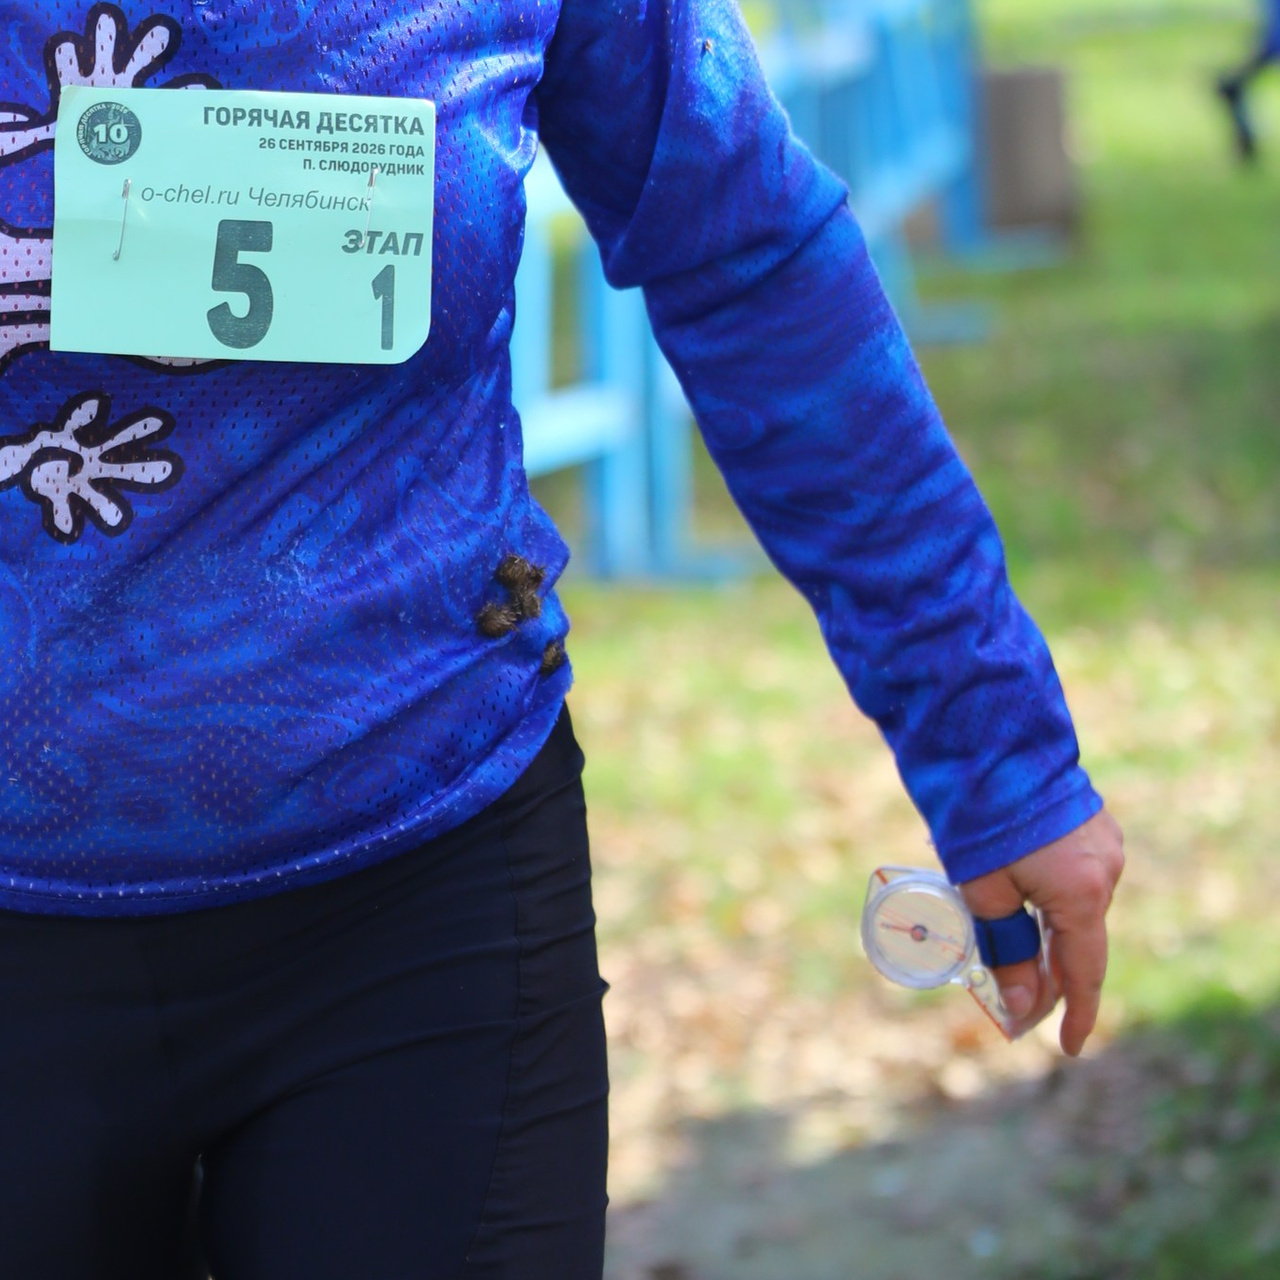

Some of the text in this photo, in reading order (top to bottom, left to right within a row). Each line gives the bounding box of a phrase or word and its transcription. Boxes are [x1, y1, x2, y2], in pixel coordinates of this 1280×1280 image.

[93, 123, 129, 144] 10
[203, 106, 425, 136] ГОРЯЧАЯ ДЕСЯТКА
[258, 137, 425, 159] 26 СЕНТЯБРЯ 2026 ГОДА
[303, 158, 425, 176] П. СЛЮДОРУДНИК
[140, 184, 371, 211] o-chel.ru Челябинск
[341, 229, 424, 257] ЭТАП
[206, 219, 274, 350] 5
[371, 264, 396, 351] 1
